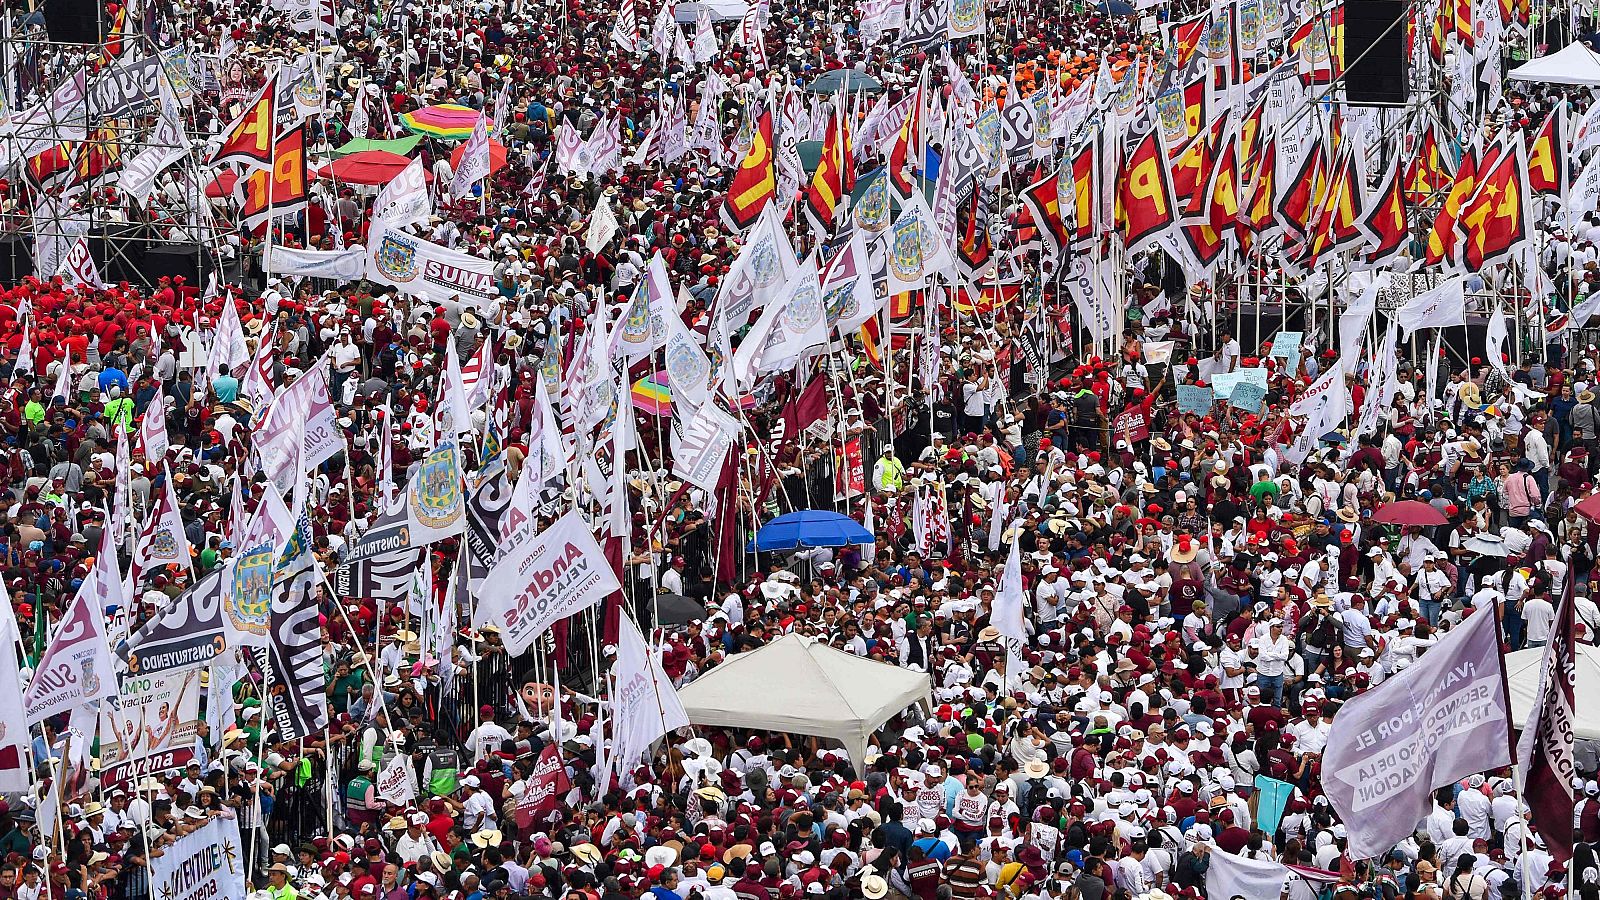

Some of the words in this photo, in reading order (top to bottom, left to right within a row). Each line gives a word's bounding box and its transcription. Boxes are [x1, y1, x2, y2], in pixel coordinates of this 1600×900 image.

[427, 261, 494, 293] SUMA
[154, 679, 165, 690] de
[271, 684, 296, 740] SOCIEDAD
[1554, 707, 1574, 745] PISO
[913, 868, 935, 878] morena
